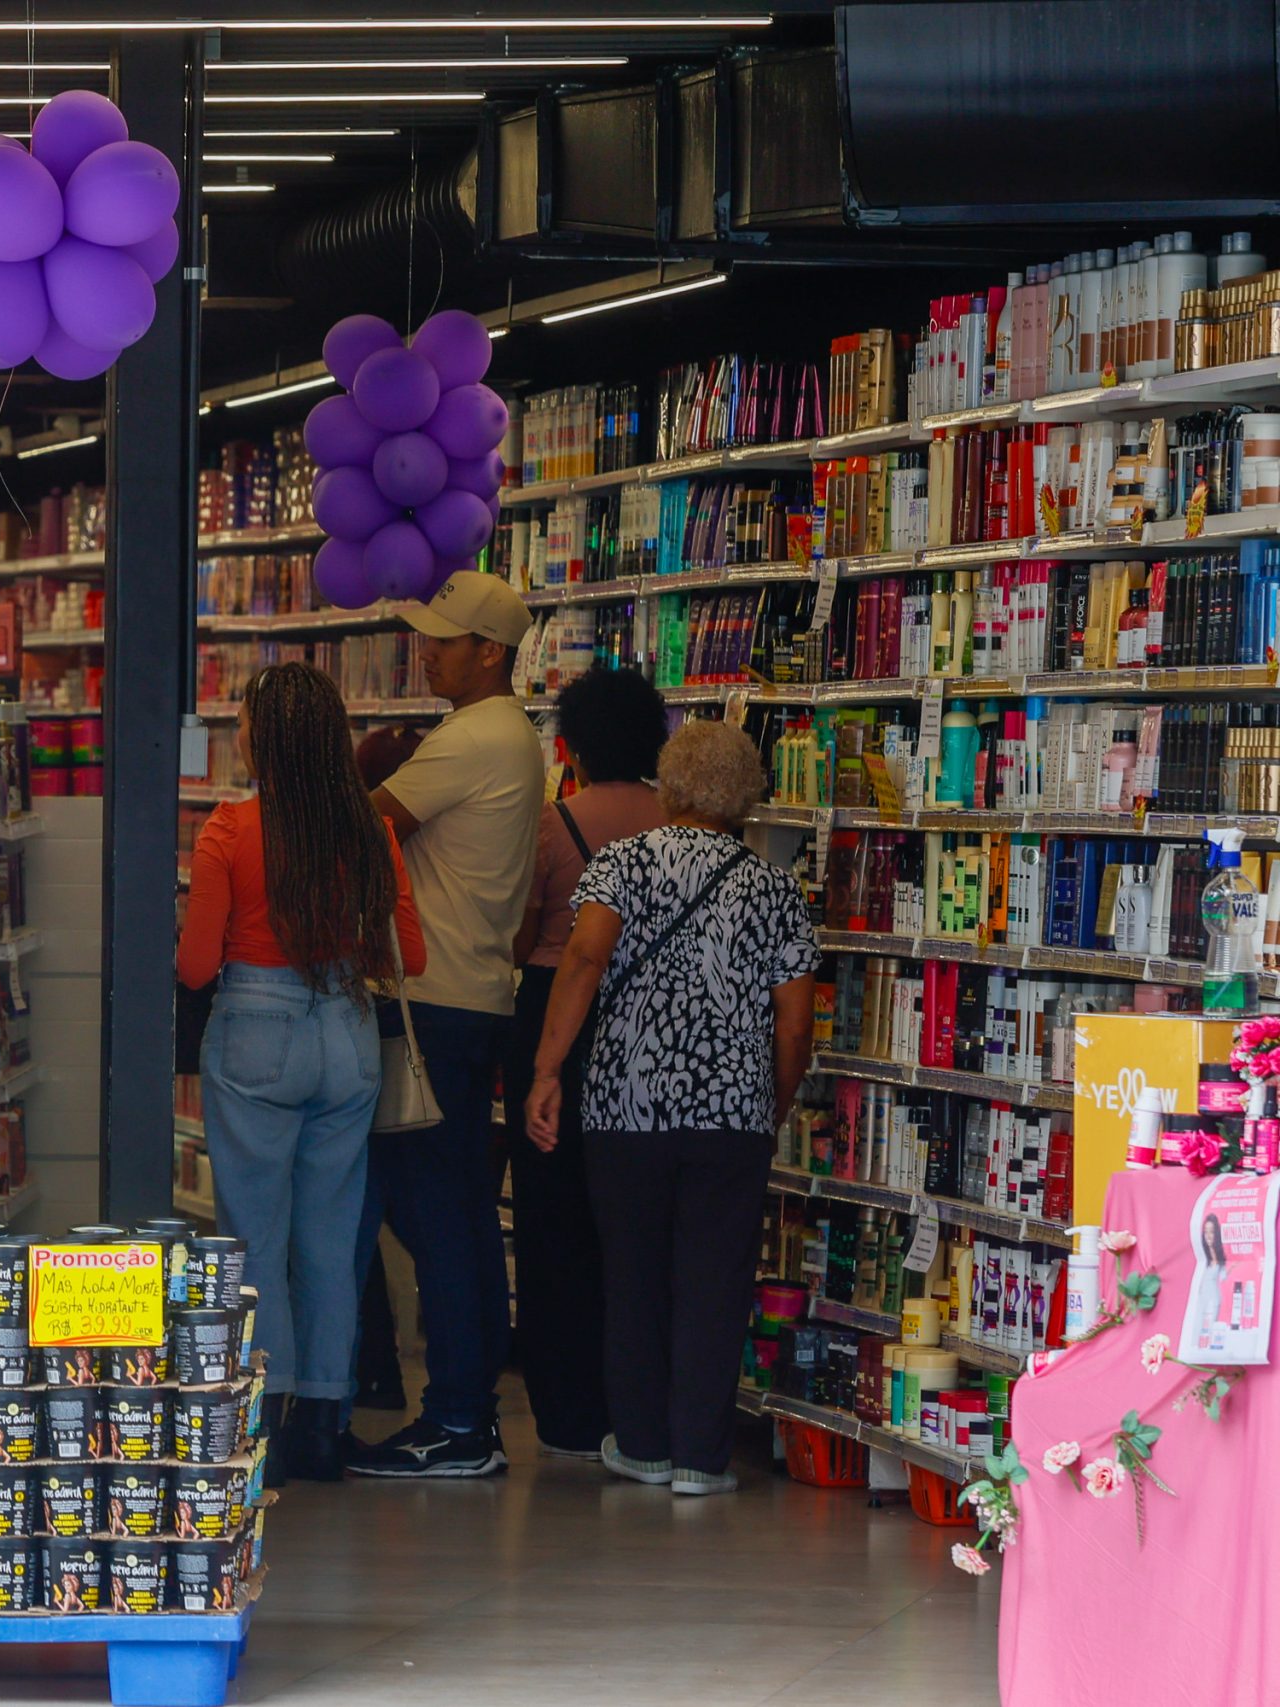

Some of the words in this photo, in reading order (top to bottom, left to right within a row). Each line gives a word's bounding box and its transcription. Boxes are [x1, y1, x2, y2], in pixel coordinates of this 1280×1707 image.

[1076, 595, 1086, 629] K-FORCE
[1232, 892, 1253, 901] SUPER
[1223, 1224, 1260, 1242] MINIATURA
[35, 1249, 155, 1271] Promoção
[81, 1272, 115, 1295] LOLA
[119, 1274, 161, 1297] MORTE
[87, 1297, 150, 1314] HIDRATANTE
[48, 1319, 72, 1336] R$
[80, 1315, 132, 1336] 39.99
[176, 1488, 202, 1501] MORTE
[60, 1561, 88, 1574] MORTE
